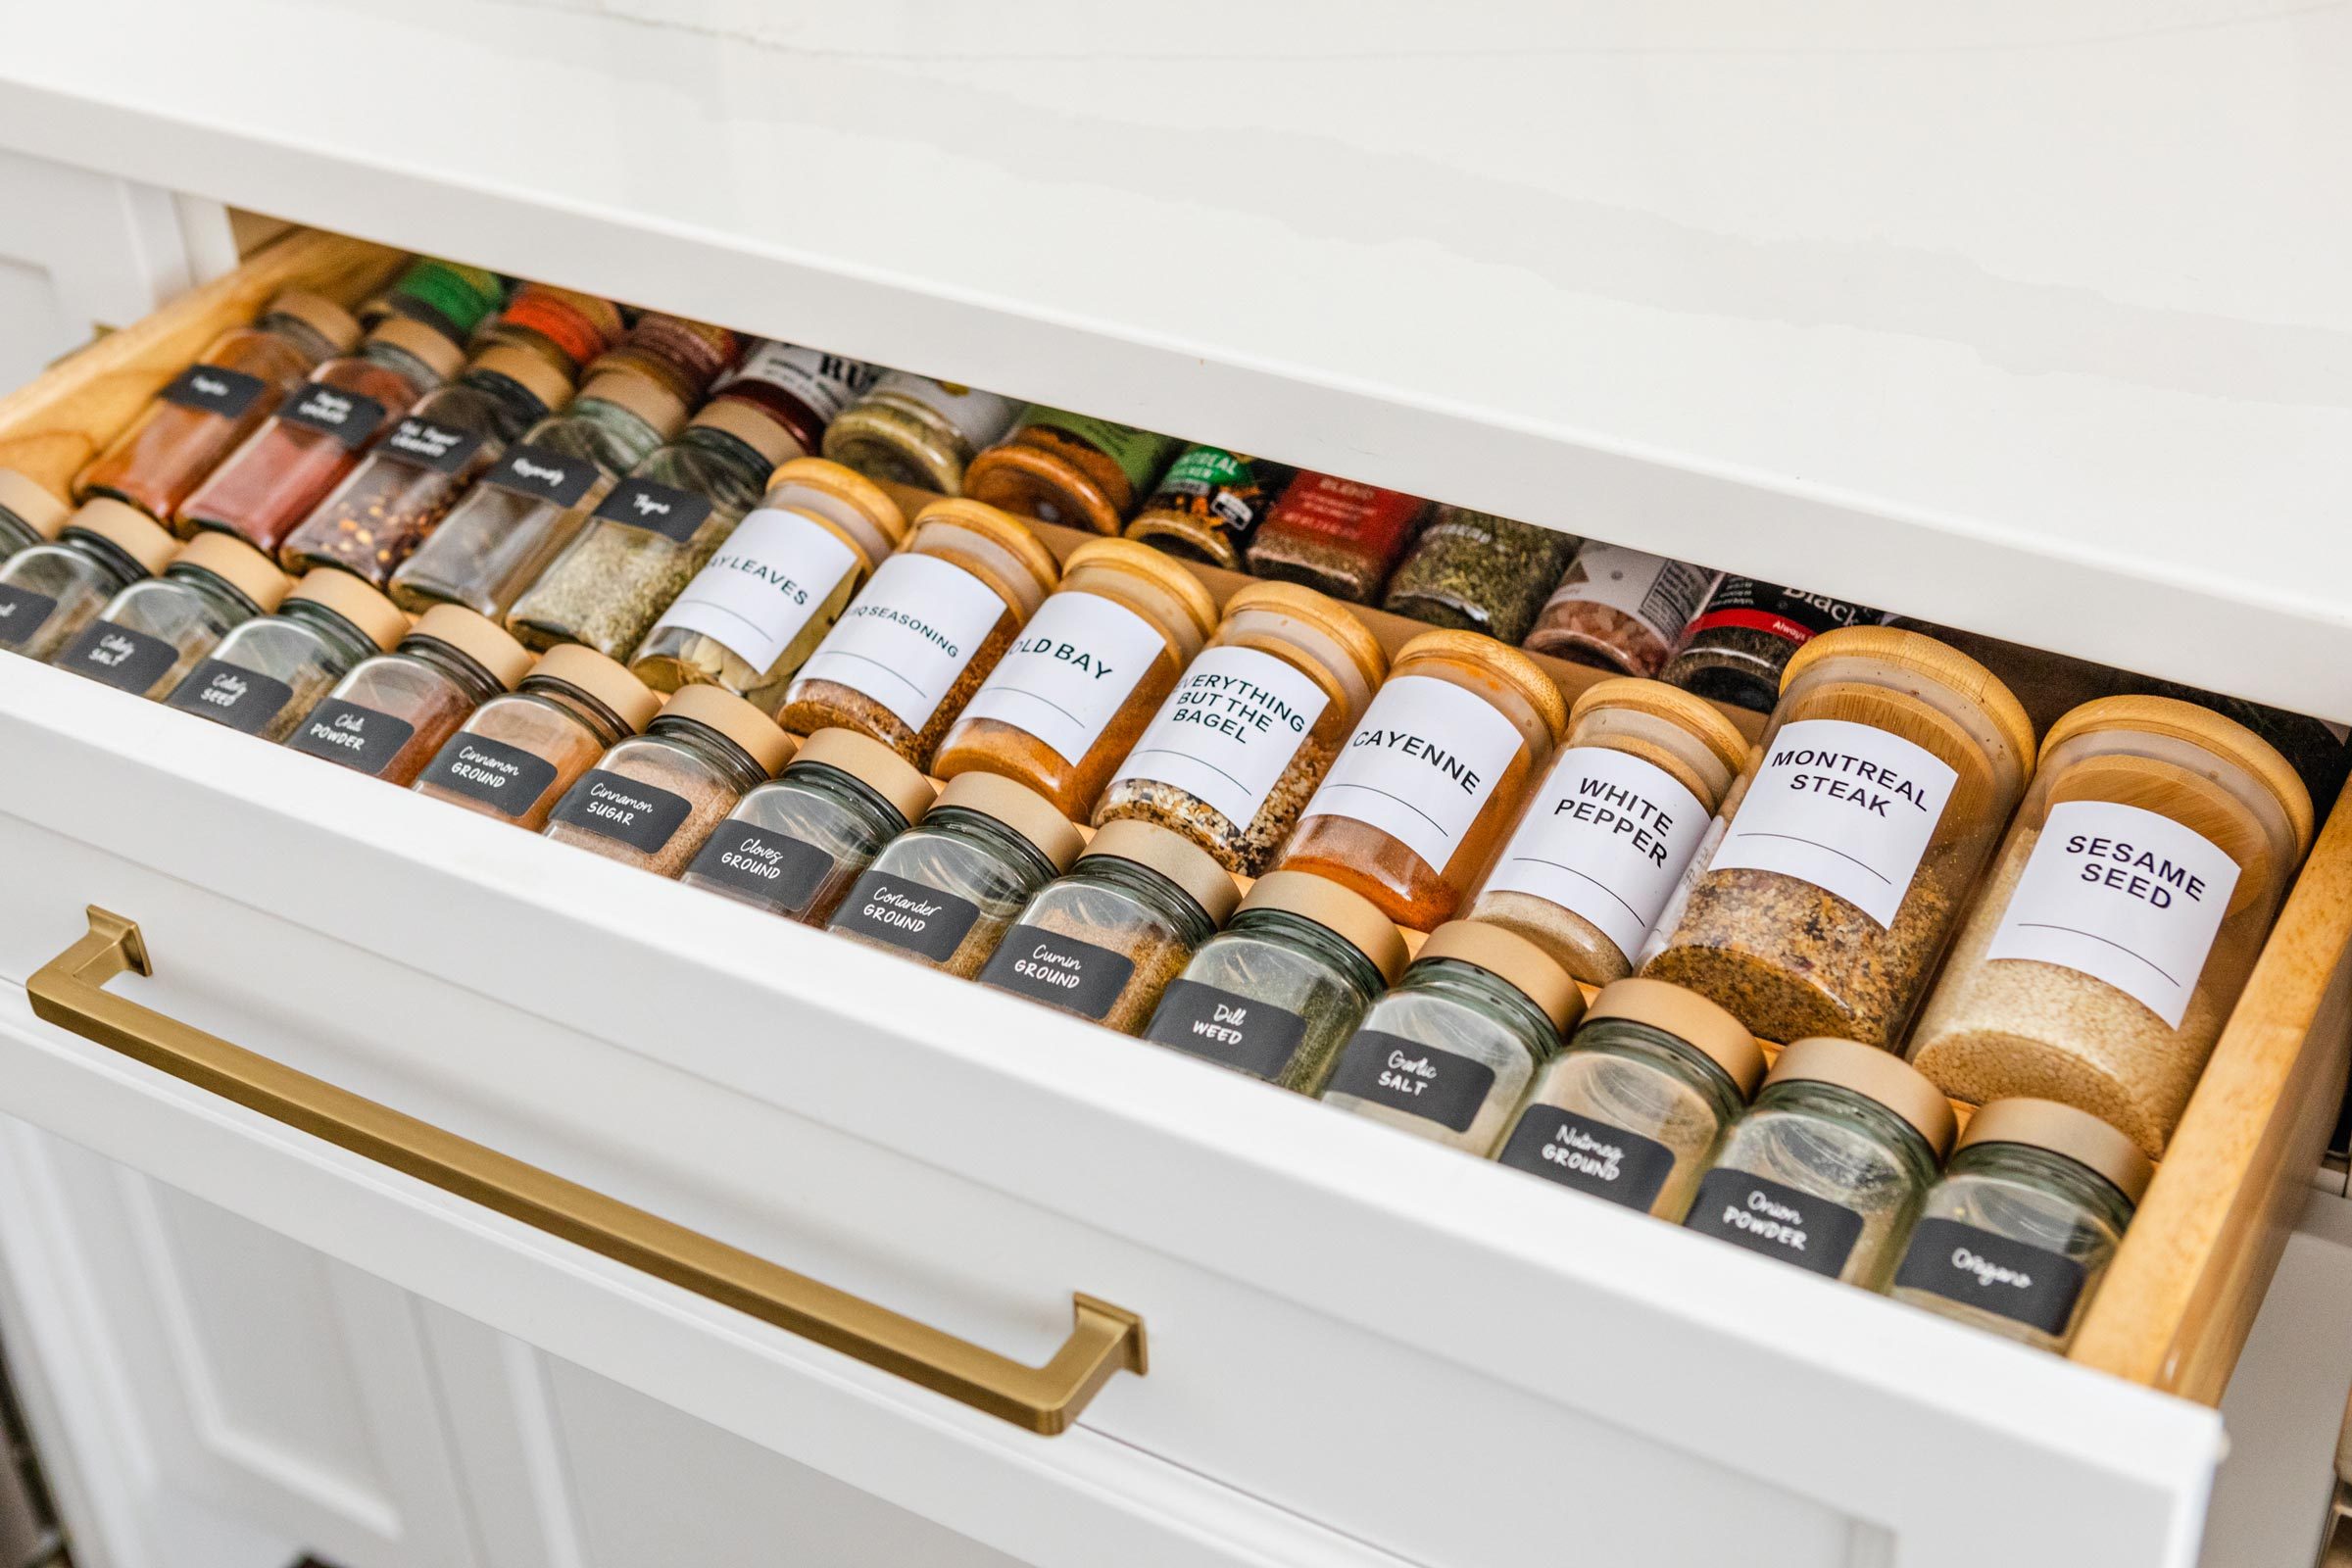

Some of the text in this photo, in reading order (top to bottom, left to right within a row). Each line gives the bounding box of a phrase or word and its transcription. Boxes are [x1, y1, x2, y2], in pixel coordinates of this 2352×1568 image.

[730, 557, 808, 606] LEAVES
[868, 606, 958, 659] SEASONING
[1773, 620, 1807, 642] Always
[1054, 643, 1112, 679] BAY
[1176, 674, 1305, 732] VERYTHING
[1177, 691, 1273, 733] BUT THE
[310, 723, 365, 751] POWDER
[1172, 709, 1247, 744] BAGEL
[451, 761, 507, 788] GROUND
[459, 745, 519, 777] Cinnamon
[1352, 730, 1481, 796] CAYENNE
[590, 782, 654, 814] Cinnamon
[1771, 750, 1929, 812] MONTREAL
[1789, 774, 1891, 818] STEAK
[586, 802, 635, 827] SUGAR
[1579, 777, 1673, 837] WHITE
[739, 838, 783, 865] Cloves
[1553, 799, 1668, 869] PEPPER
[721, 851, 781, 880] GROUND
[2066, 835, 2206, 902] SESAME
[873, 886, 942, 917] Coriander
[2081, 863, 2172, 909] SEED
[863, 904, 926, 933] GROUND
[1014, 958, 1080, 990] GROUND
[1032, 944, 1081, 971] Cumin
[1192, 1020, 1243, 1046] WEED
[1213, 1004, 1247, 1027] Dill
[1388, 1050, 1437, 1079] Garlic
[1378, 1071, 1428, 1097] SALT
[1556, 1124, 1625, 1162] Nutmeg
[1542, 1144, 1620, 1182] GROUND
[1747, 1190, 1802, 1225] Onion
[1722, 1205, 1808, 1251] POWDER
